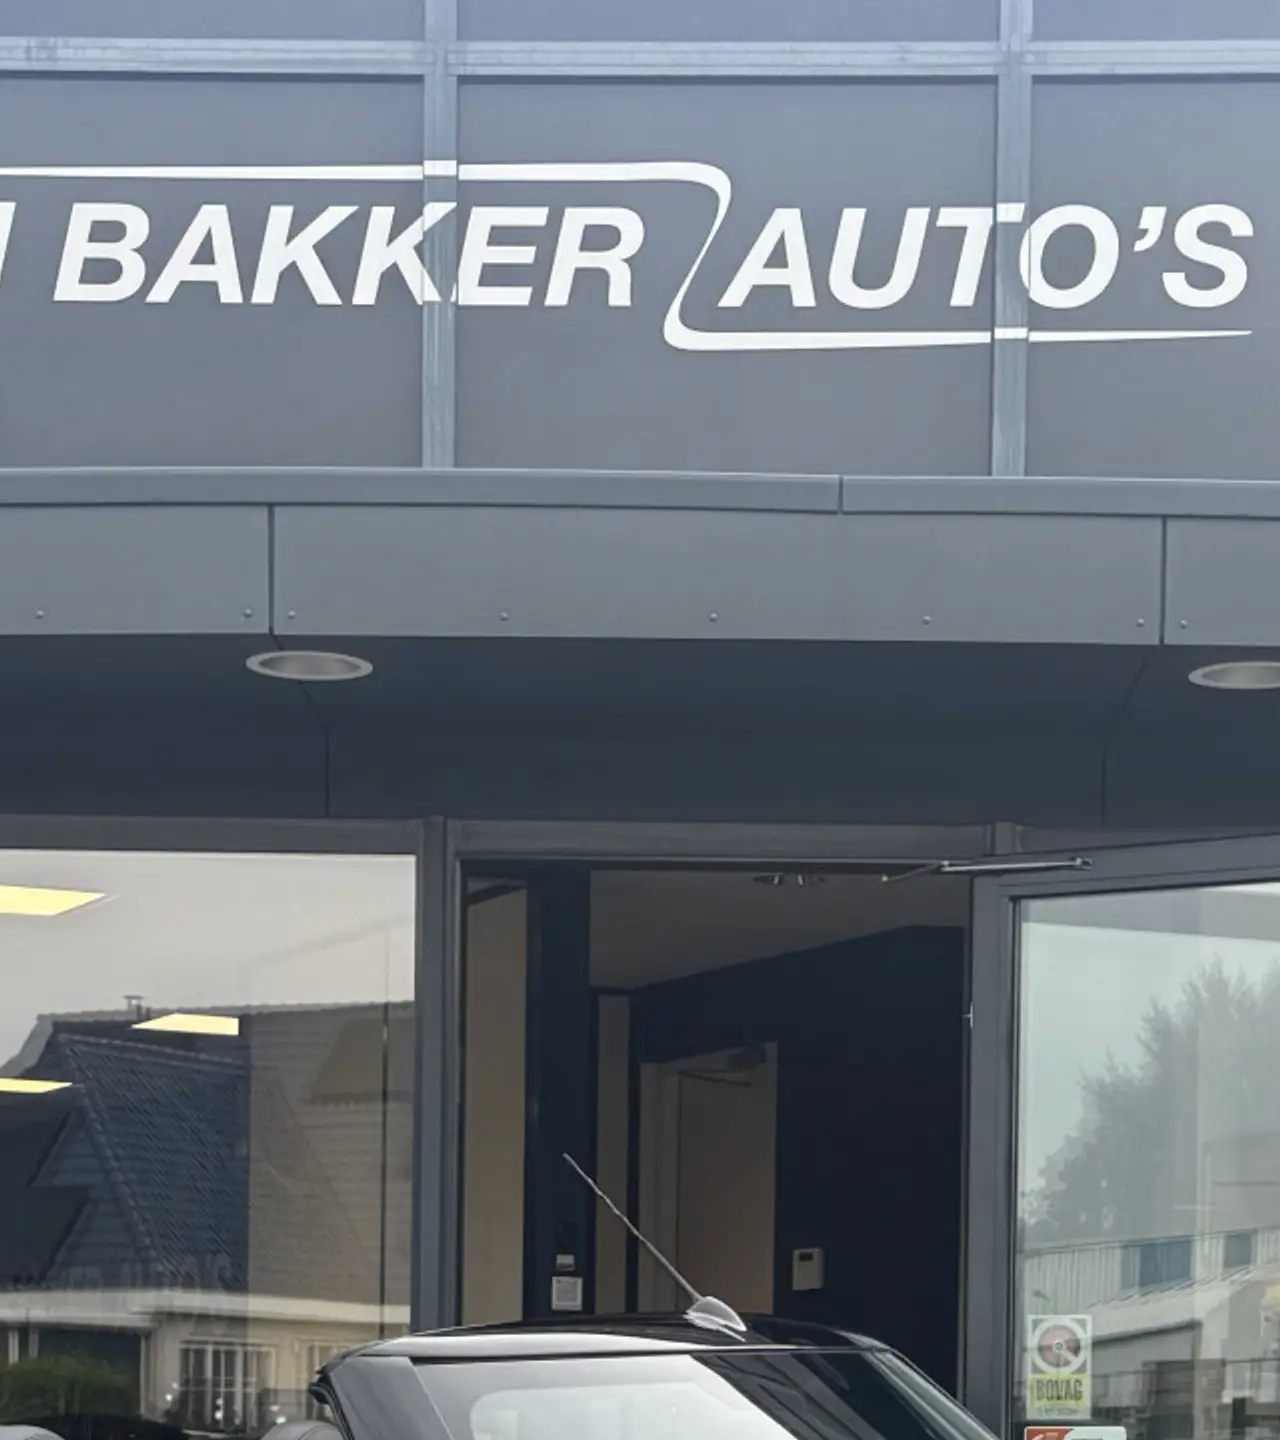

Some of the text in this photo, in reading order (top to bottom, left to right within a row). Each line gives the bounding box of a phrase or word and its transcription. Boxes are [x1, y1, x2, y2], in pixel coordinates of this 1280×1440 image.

[53, 199, 645, 307] BAKKER
[718, 203, 1254, 310] AUTO'S
[1035, 1378, 1084, 1401] BOVAG
